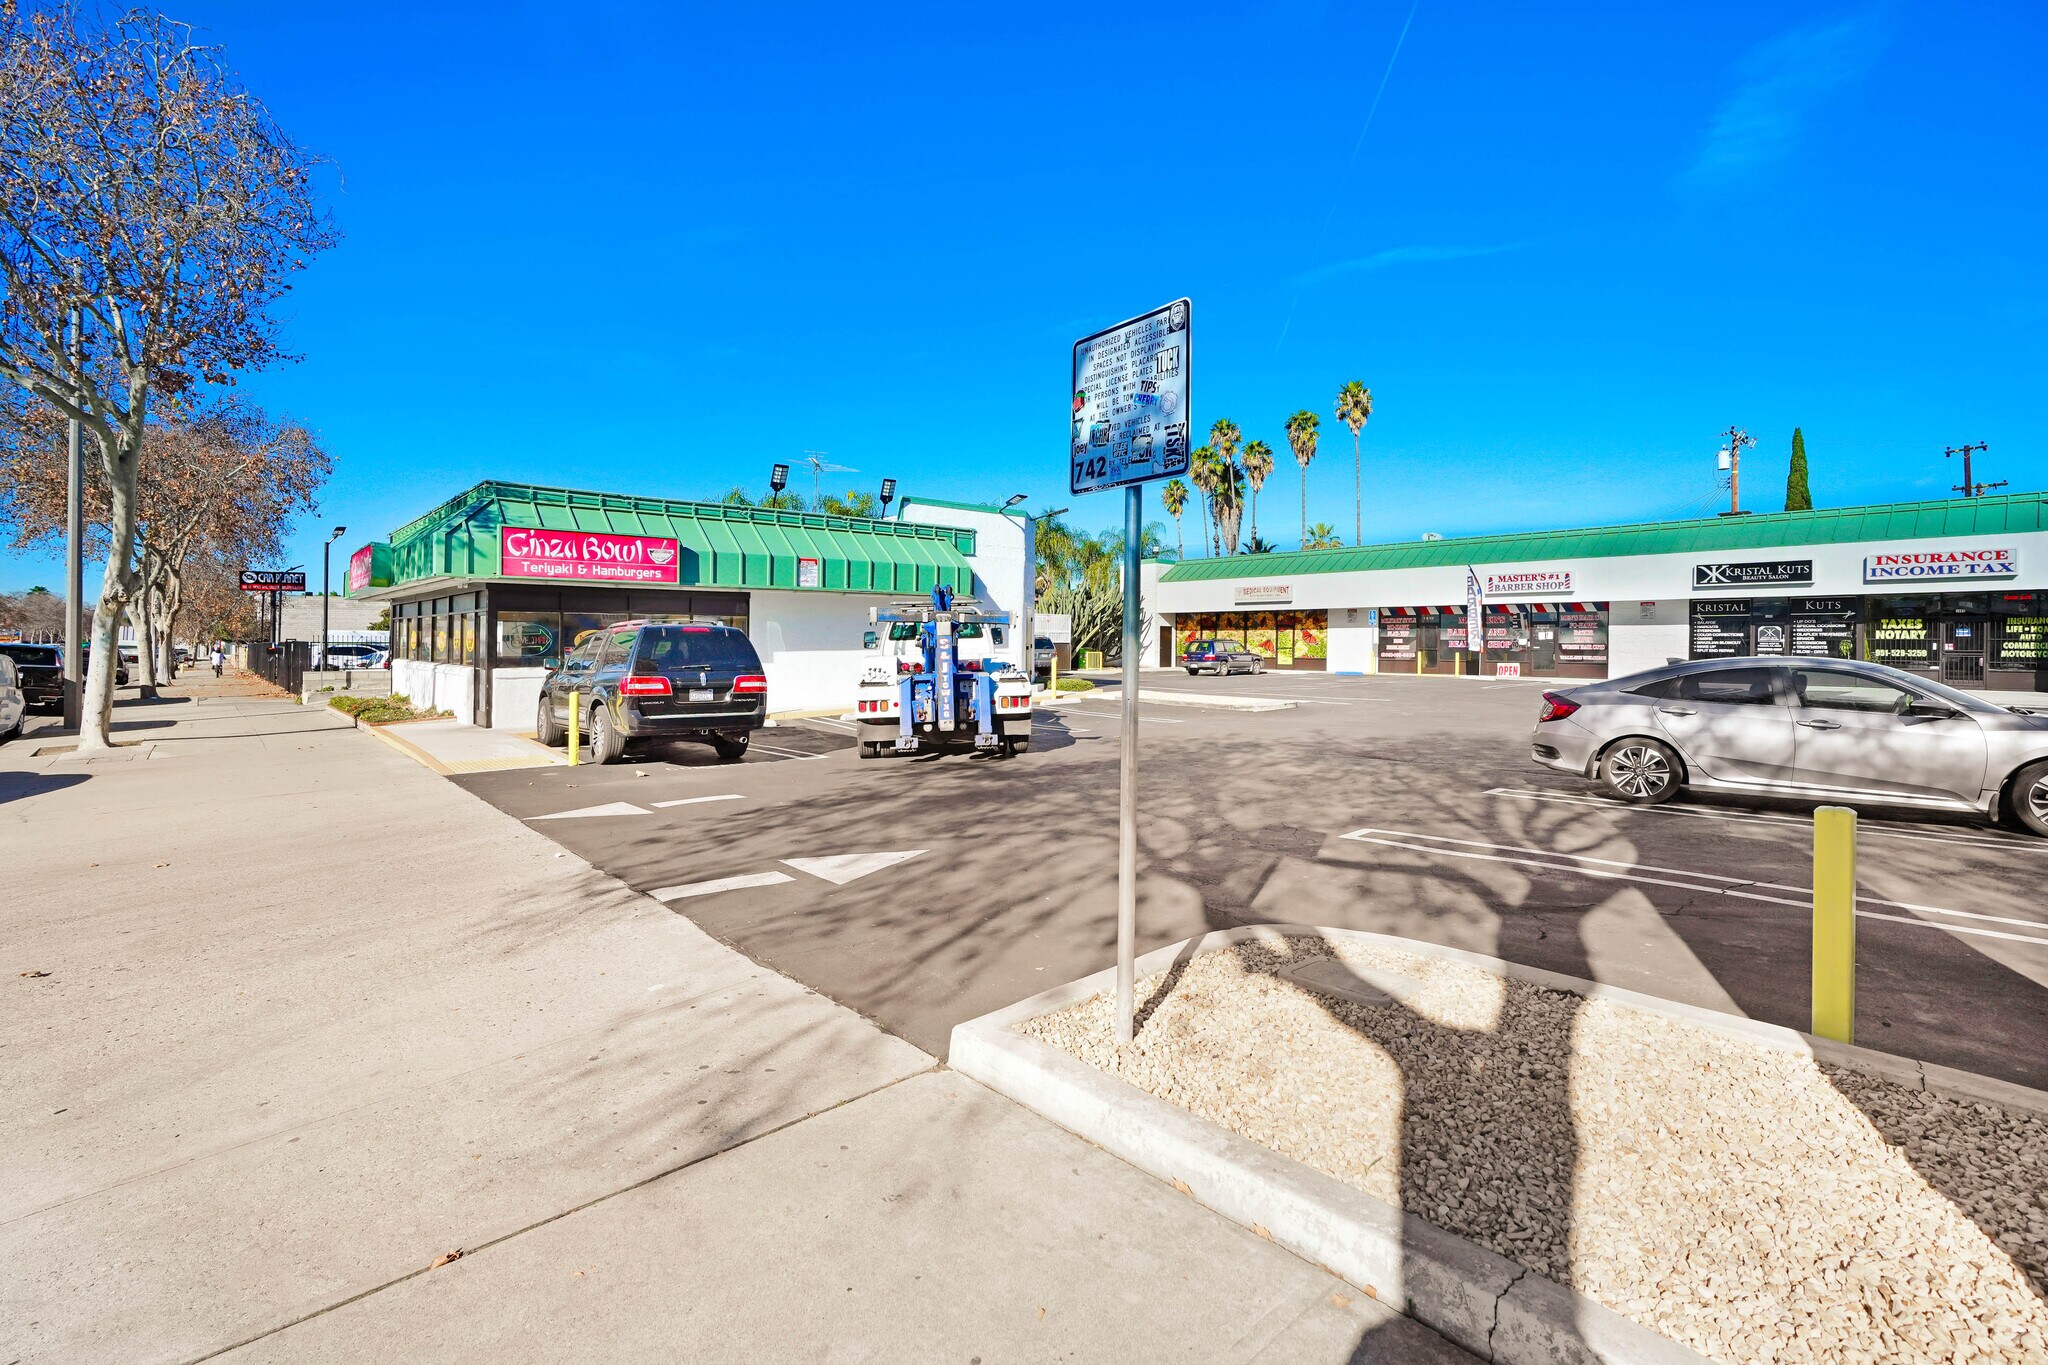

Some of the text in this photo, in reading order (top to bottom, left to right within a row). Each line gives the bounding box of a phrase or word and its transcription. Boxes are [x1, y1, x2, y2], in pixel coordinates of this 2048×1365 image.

[1081, 335, 1121, 355] UNAUTHORIZED
[1125, 323, 1152, 338] VEHICLES
[1089, 327, 1170, 363] IN DESIGNATED ACCESSIBLE
[1093, 340, 1165, 371] SPACES NOT DISPLAYING
[1157, 346, 1179, 374] TUCK
[1082, 366, 1153, 393] PECIAL LICENSE PLATES
[1085, 364, 1127, 384] DISTINGUISHING
[1095, 387, 1119, 401] PERSONS
[1123, 382, 1136, 392] WITH
[1096, 400, 1108, 410] WILL
[1112, 398, 1119, 406] BE
[1099, 411, 1109, 420] THE
[1112, 404, 1137, 416] OWNER'S
[1125, 415, 1150, 428] VEHICLES
[1120, 426, 1150, 440] RECLAIMED
[1154, 422, 1160, 432] AT
[1075, 456, 1106, 484] 742
[506, 529, 643, 564] Ginza Bowl
[1876, 550, 2009, 566] INSURANCE
[521, 561, 662, 580] Teriyaki & Hamburgers
[1497, 573, 1547, 583] MASTER'S
[1726, 565, 1810, 577] KRISTAL KUTS
[1870, 562, 2015, 578] INCOME TAX
[1494, 582, 1564, 592] BARBER SHOP
[1696, 603, 1746, 612] KRISTAL
[1805, 600, 1841, 610] KUTS
[1880, 618, 1923, 630] TAXES
[2006, 625, 2023, 633] LIFE
[1875, 630, 1928, 640] NOTARY
[2019, 633, 2042, 641] AUTO
[1498, 665, 1518, 676] OPEN
